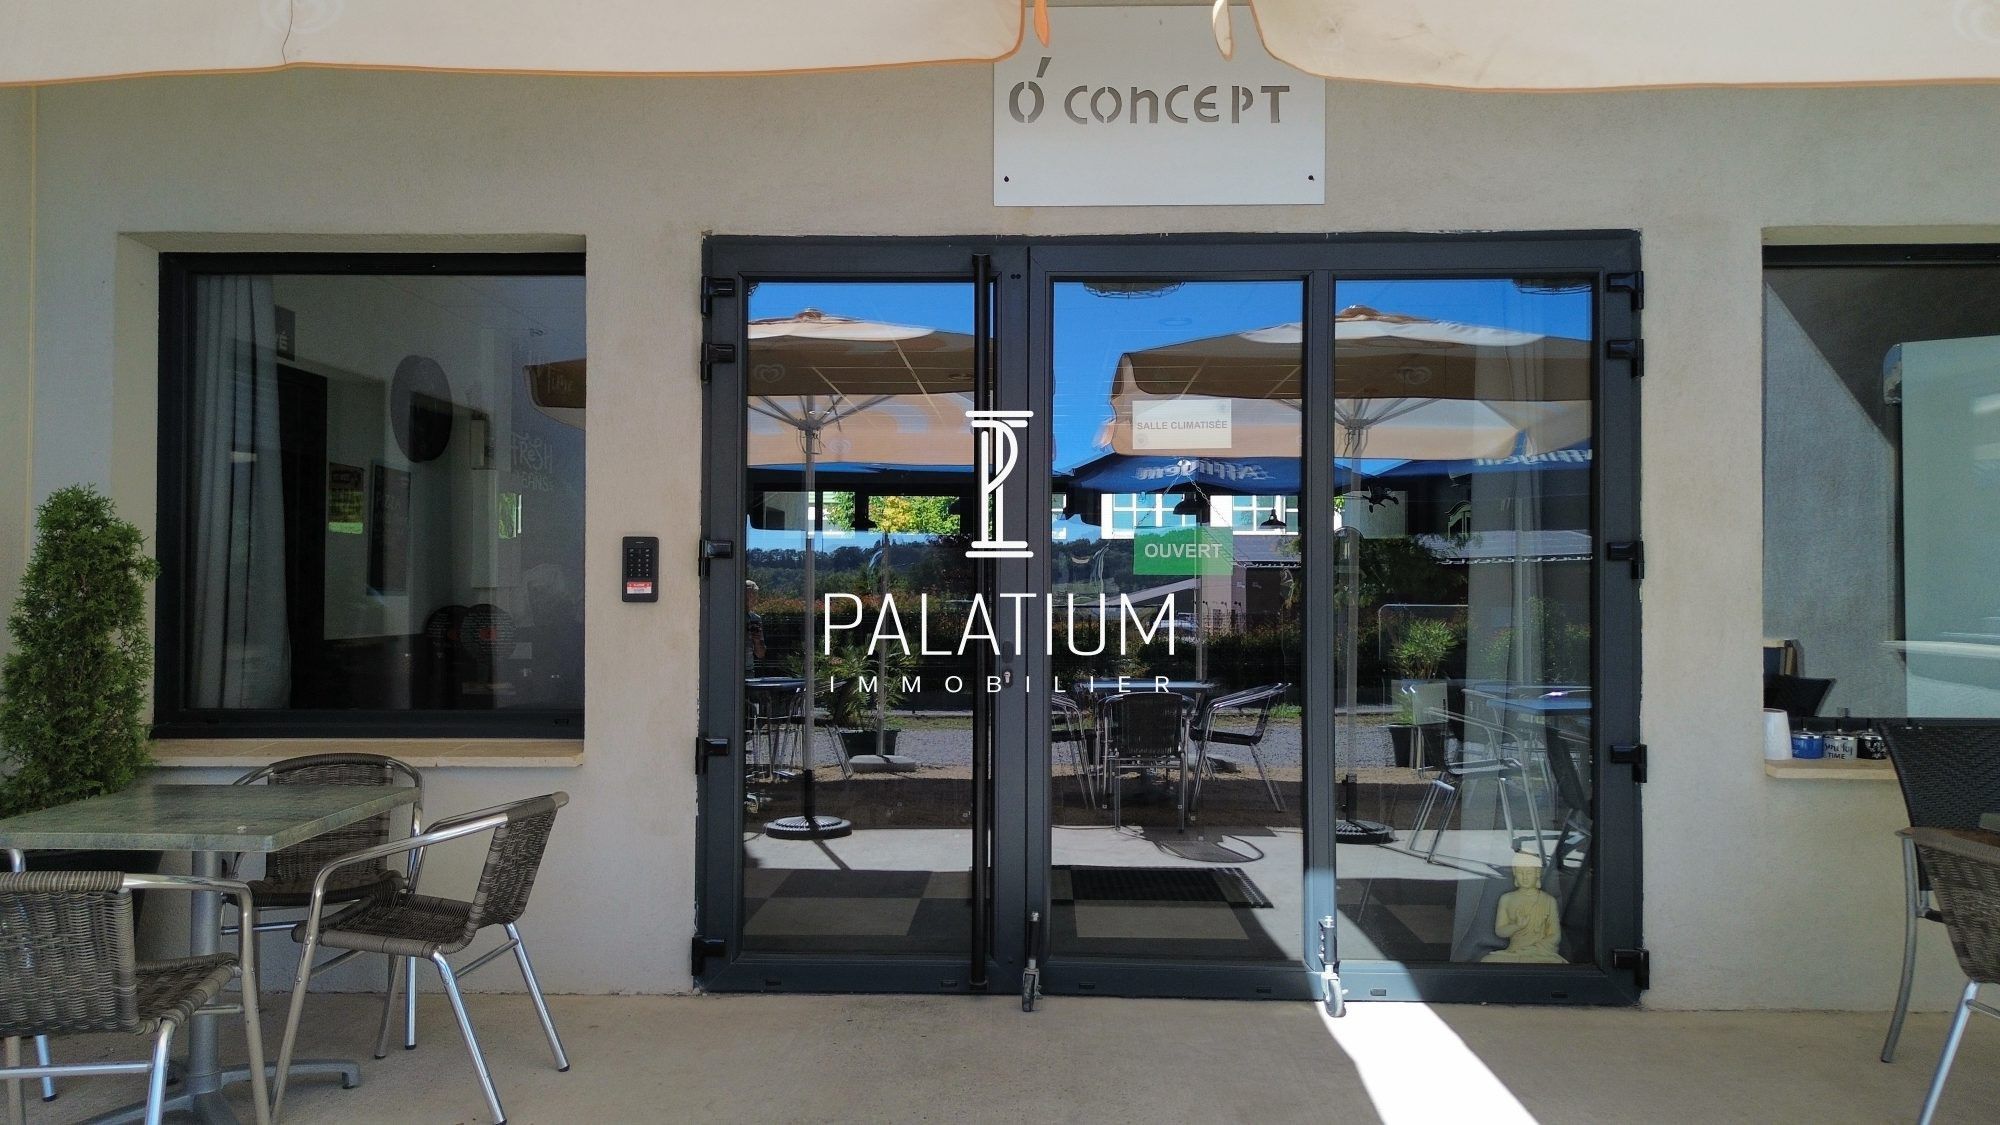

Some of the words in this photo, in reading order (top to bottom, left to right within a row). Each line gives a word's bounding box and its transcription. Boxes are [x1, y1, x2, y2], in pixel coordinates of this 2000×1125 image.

[1137, 421, 1169, 430] SALLE
[1170, 419, 1228, 430] CLIMATISÉE
[1144, 543, 1223, 559] OUVERT
